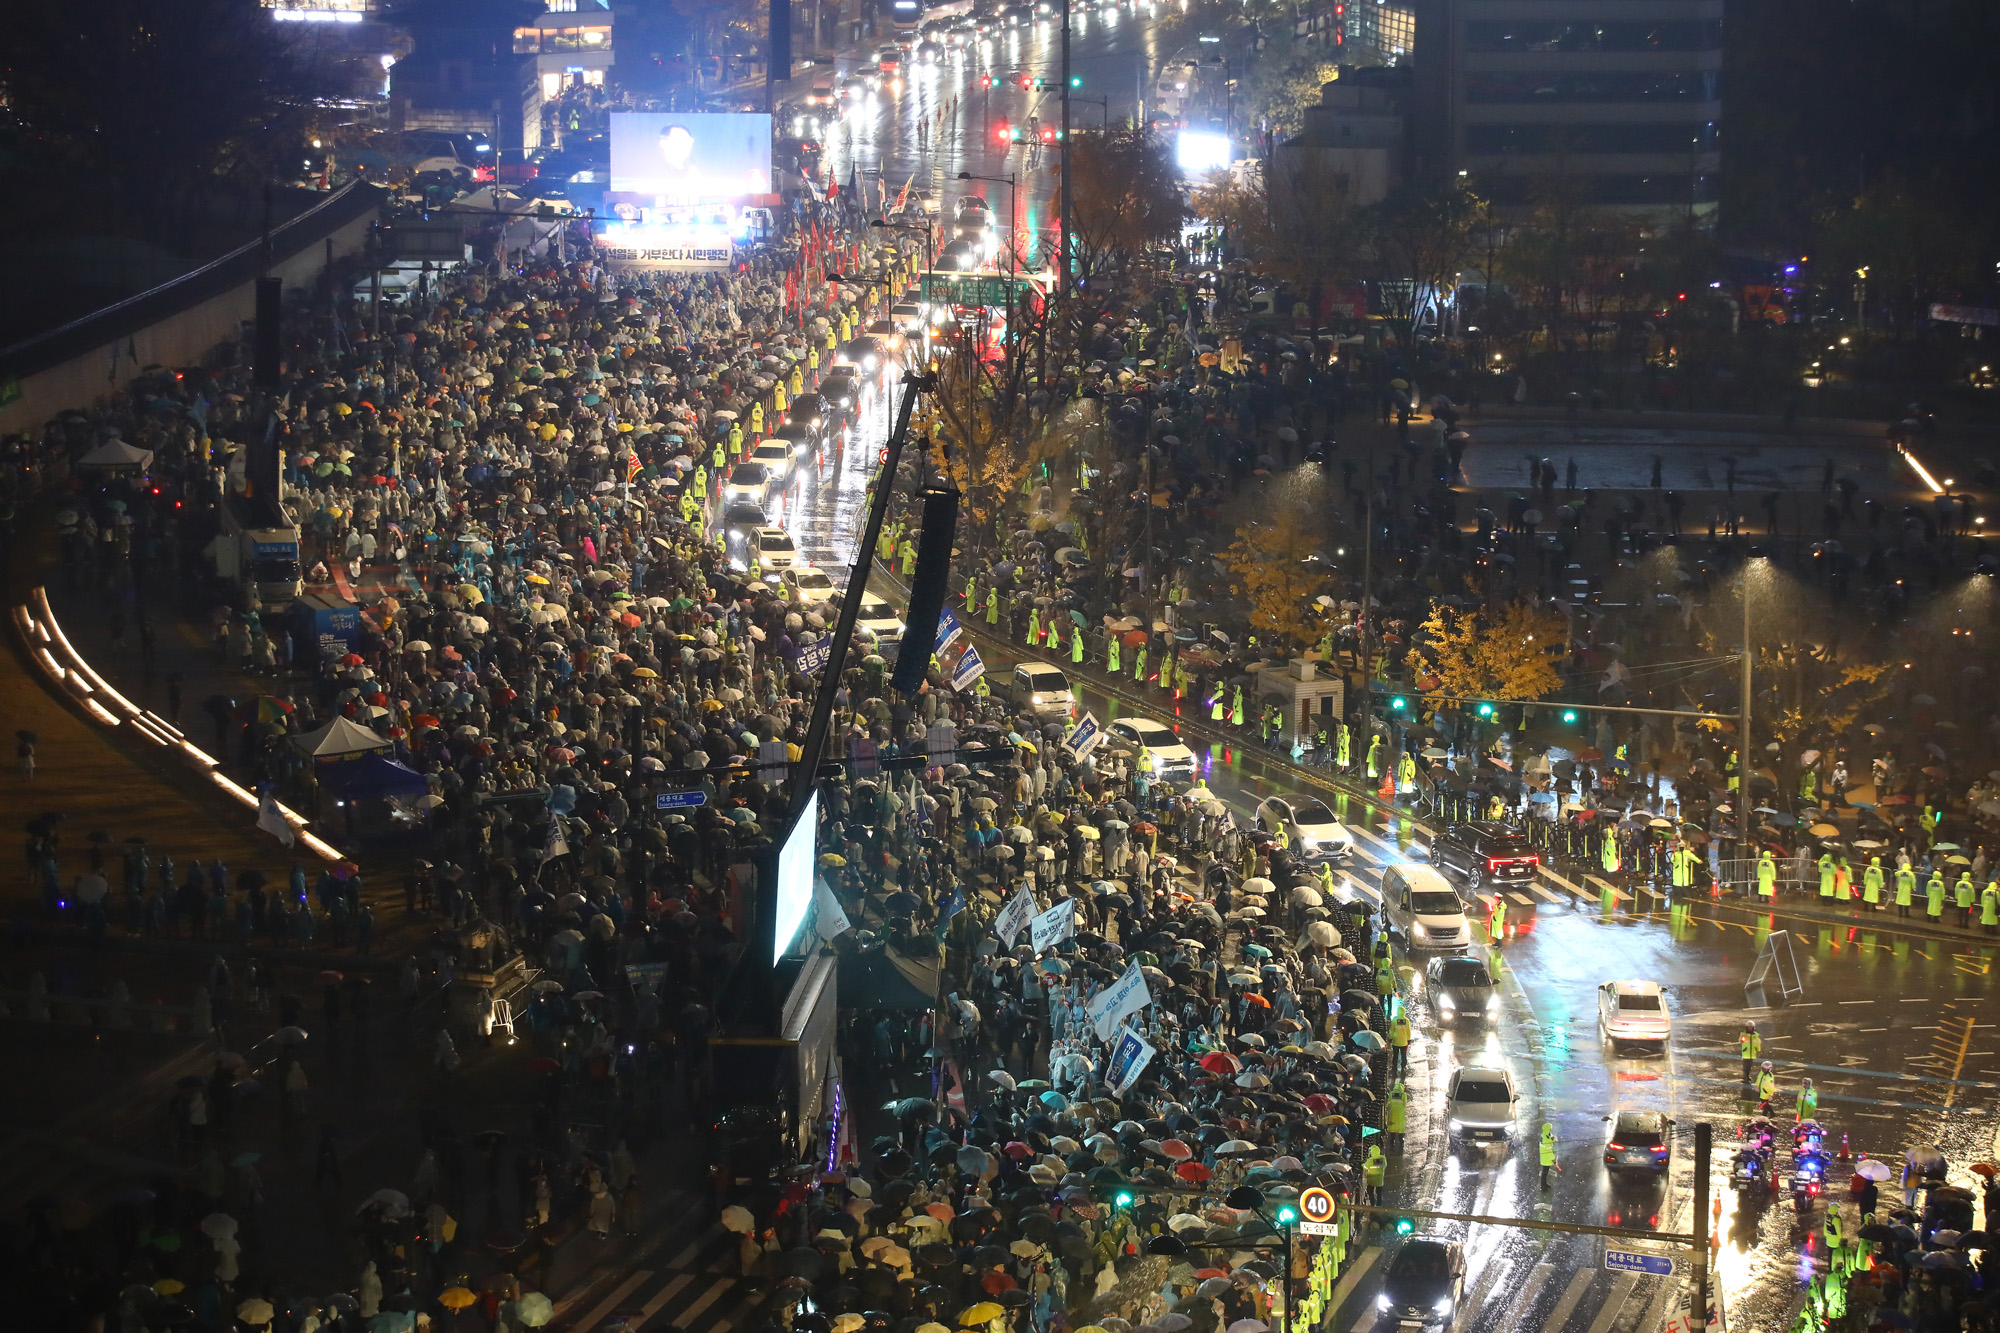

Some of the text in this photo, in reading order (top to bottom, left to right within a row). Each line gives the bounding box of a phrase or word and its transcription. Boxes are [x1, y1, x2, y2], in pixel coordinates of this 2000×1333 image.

[602, 248, 728, 261] 석열을 거부한다 시민행진
[659, 794, 685, 802] 세종대로
[1307, 1196, 1327, 1213] 40
[1303, 1223, 1336, 1233] 도심부
[1608, 1252, 1644, 1264] 세종대로
[1608, 1261, 1647, 1271] Sejong-daero
